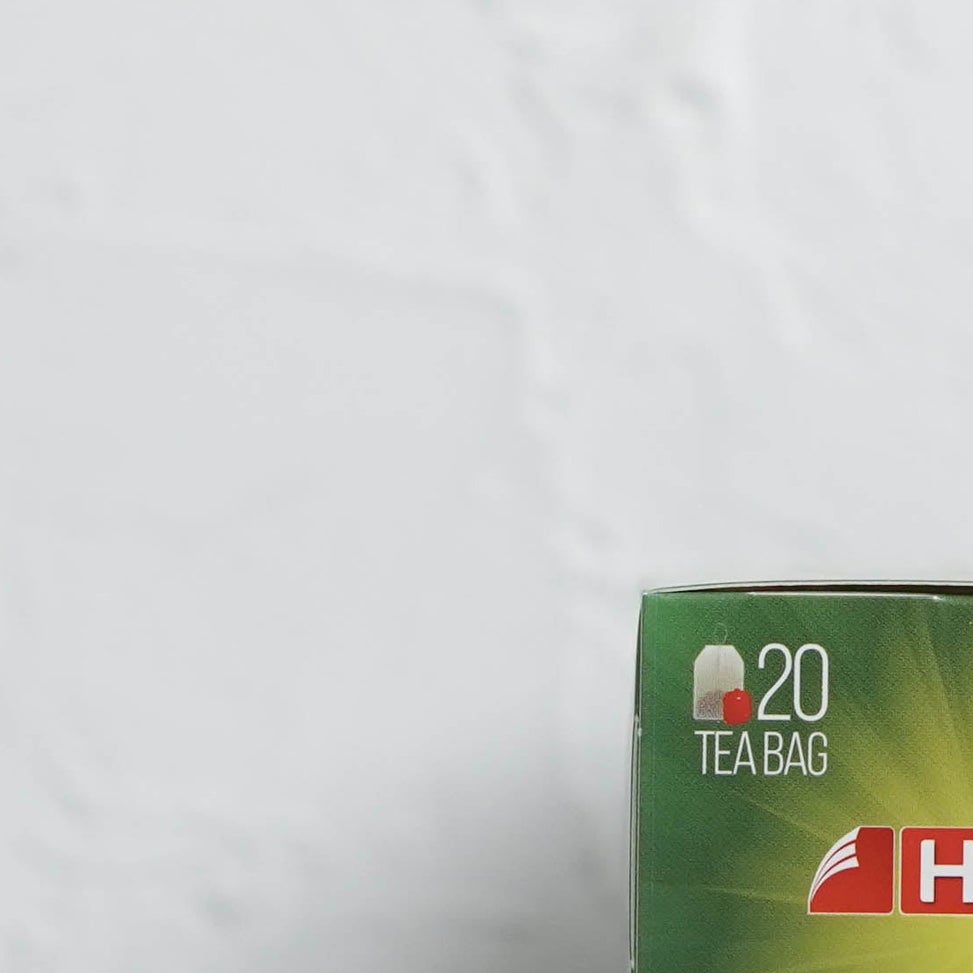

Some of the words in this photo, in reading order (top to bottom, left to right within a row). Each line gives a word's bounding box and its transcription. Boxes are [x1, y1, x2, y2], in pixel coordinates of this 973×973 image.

[757, 642, 829, 722] 20
[694, 730, 757, 776] TEA
[762, 731, 828, 777] BAG
